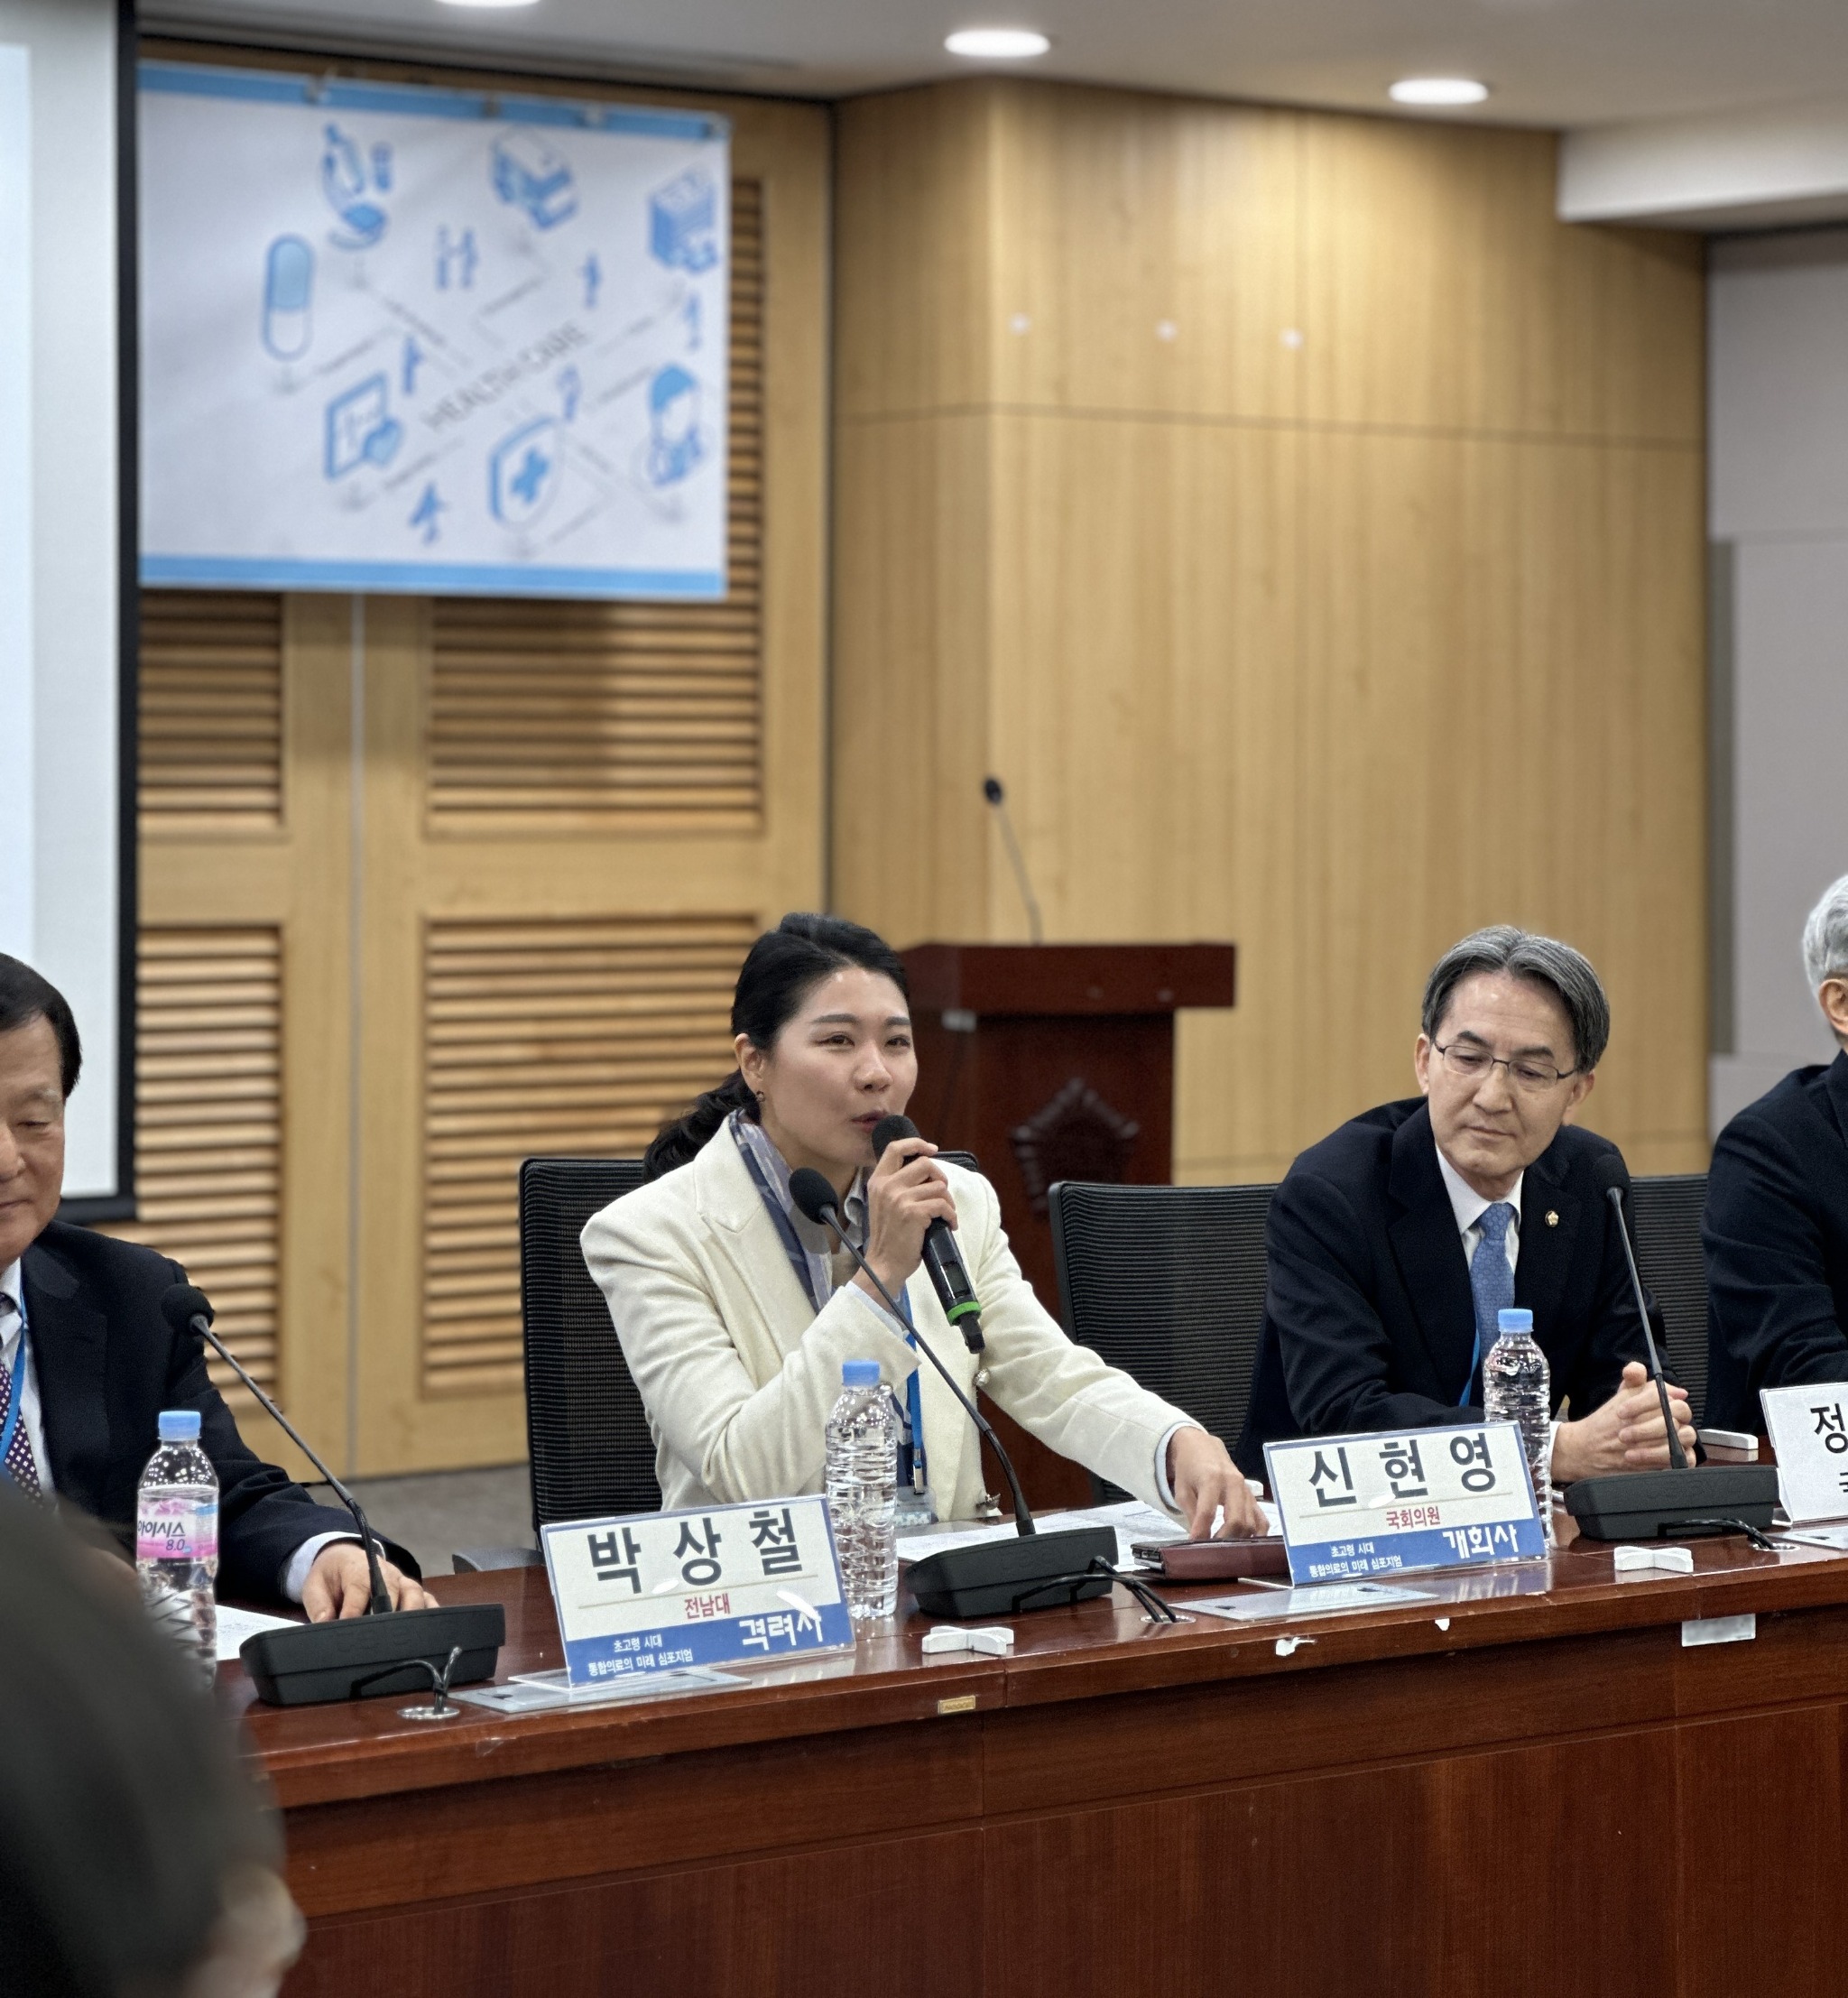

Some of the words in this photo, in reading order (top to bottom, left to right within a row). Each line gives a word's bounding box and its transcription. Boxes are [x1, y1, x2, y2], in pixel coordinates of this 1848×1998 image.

[1308, 1432, 1496, 1507] 신현영
[1386, 1506, 1441, 1529] 국회의원
[166, 1539, 186, 1551] 8.0
[587, 1509, 803, 1594] 박상철
[1358, 1541, 1375, 1554] 시대
[1443, 1524, 1518, 1559] 개회사
[1351, 1559, 1369, 1572] 미래
[1371, 1555, 1403, 1570] 심포지엄
[685, 1593, 731, 1619] 전남대
[614, 1637, 641, 1652] 초고령
[644, 1633, 663, 1649] 시대
[739, 1612, 822, 1651] 격려사
[588, 1657, 633, 1676] 통합의료의
[635, 1653, 656, 1668] 미래
[659, 1648, 694, 1666] 심포지엄
